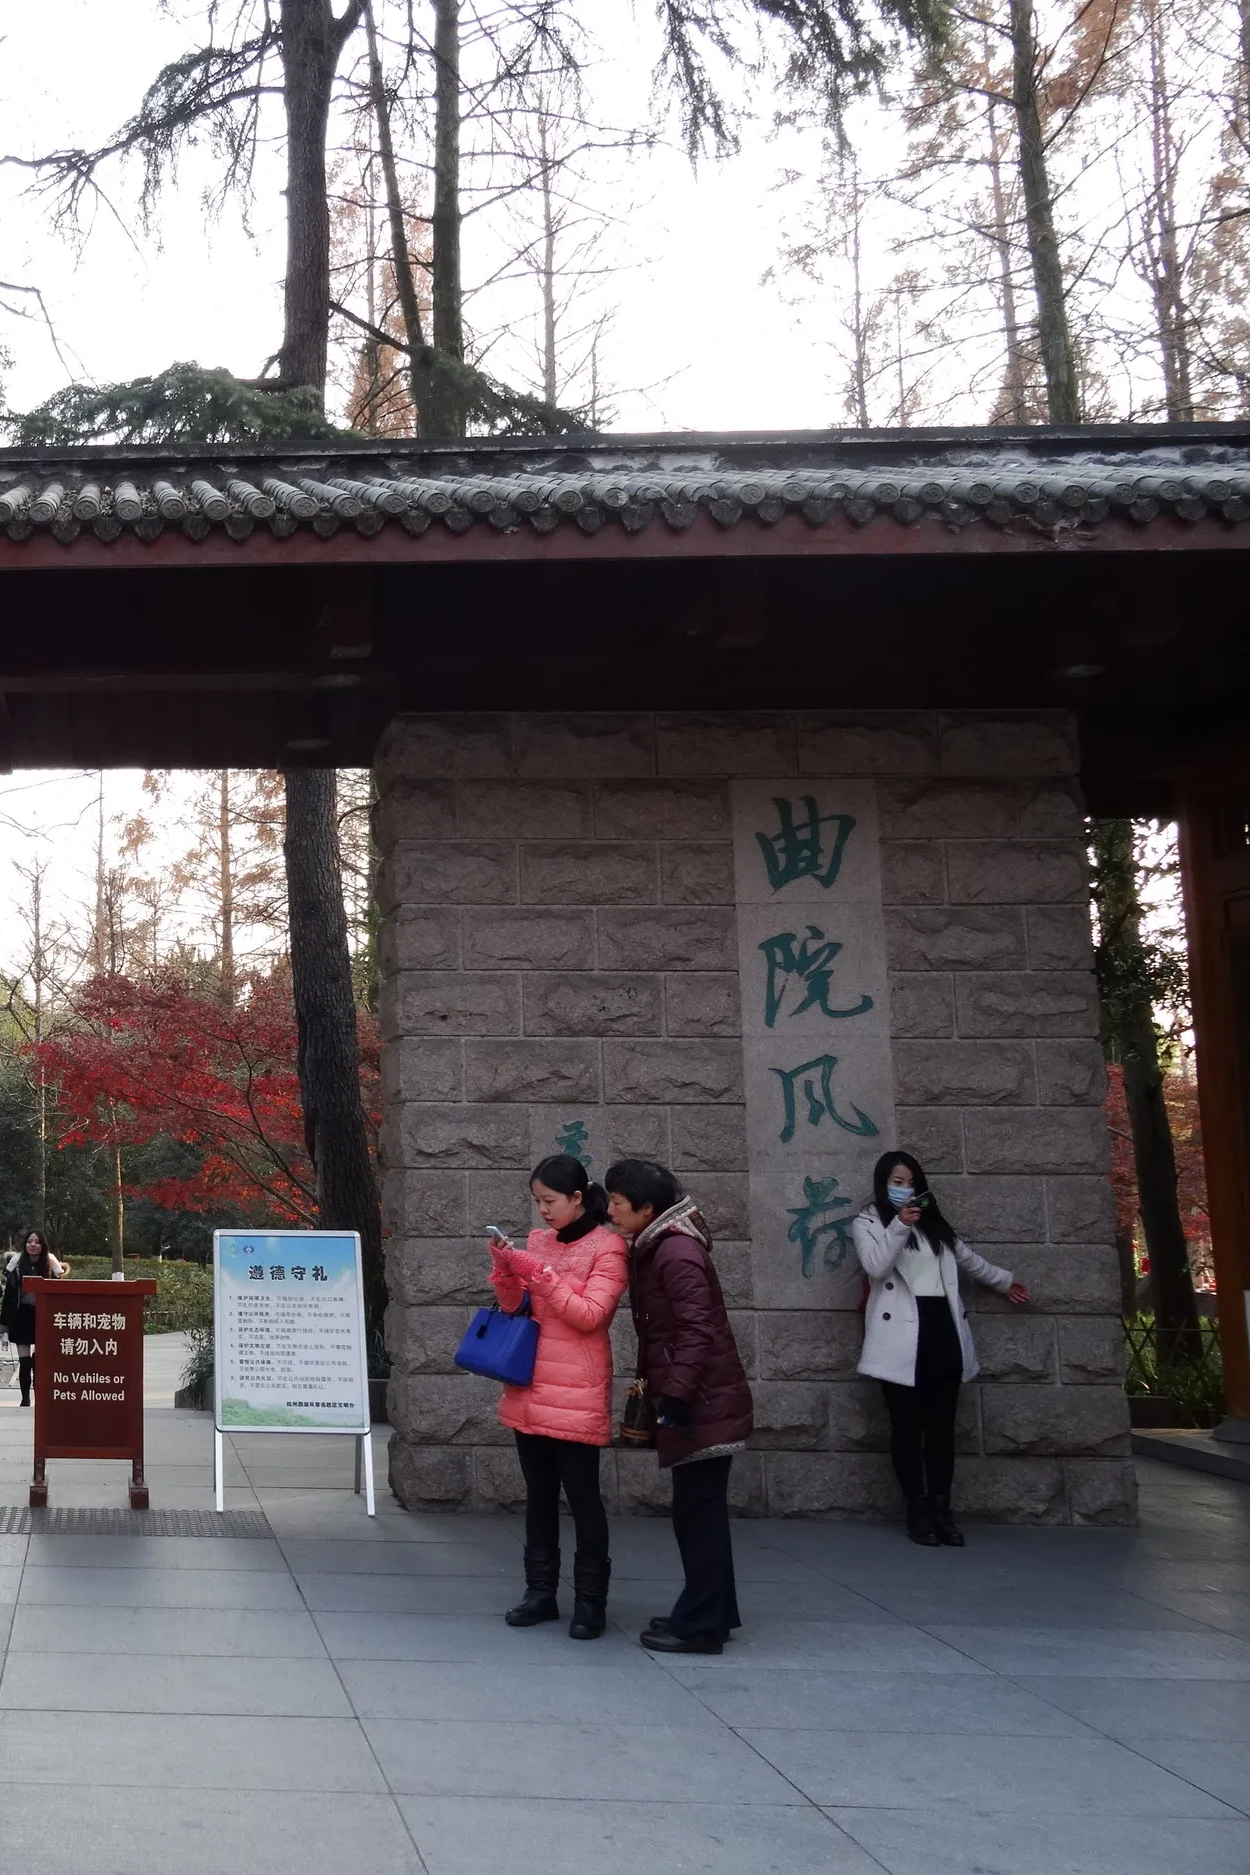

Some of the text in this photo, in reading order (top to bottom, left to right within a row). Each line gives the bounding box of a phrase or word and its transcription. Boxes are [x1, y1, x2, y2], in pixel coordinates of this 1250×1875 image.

[248, 1265, 329, 1282] 遵德守礼
[53, 1312, 126, 1330] 车辆和宠物
[60, 1338, 118, 1356] 请勿入内
[53, 1372, 125, 1384] No Vehiles or
[53, 1389, 125, 1401] Pets Allowed
